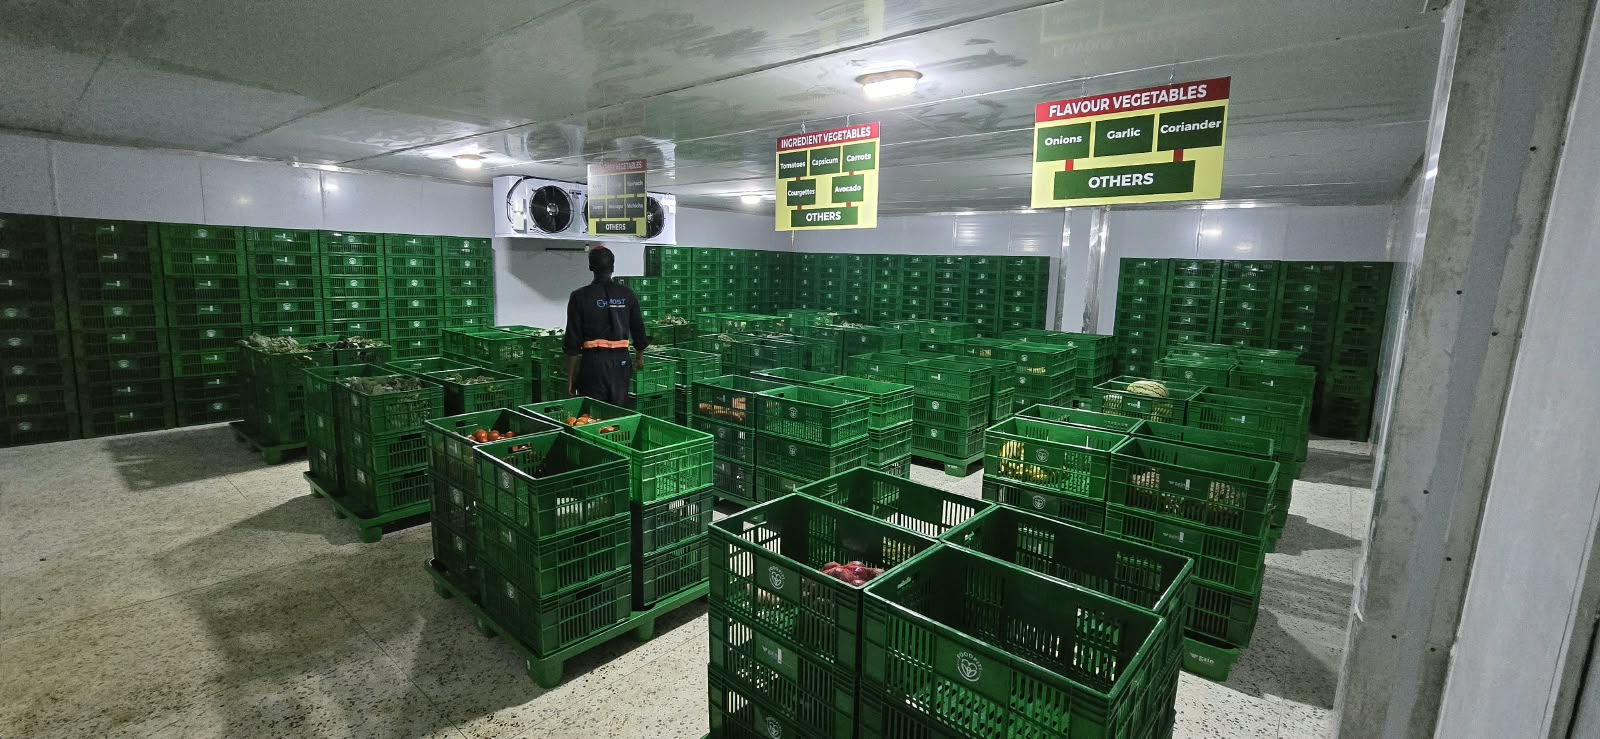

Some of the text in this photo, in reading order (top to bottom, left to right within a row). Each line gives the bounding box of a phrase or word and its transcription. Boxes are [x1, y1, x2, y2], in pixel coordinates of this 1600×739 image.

[1049, 84, 1208, 118] FLAVOUR VEGETABLES
[1160, 119, 1222, 134] Coriander
[781, 126, 871, 149] INGREDIENT VEGETABLES
[1106, 127, 1141, 140] Garlic
[1044, 134, 1082, 146] Onions
[811, 157, 839, 167] Capsicum
[846, 153, 872, 162] Carrots
[780, 161, 806, 170] Tomatoes
[1088, 172, 1154, 189] OTHERS
[787, 188, 816, 198] Courgettes
[834, 184, 862, 193] Avocado
[805, 211, 842, 222] OTHERS
[605, 223, 626, 231] OTHERS
